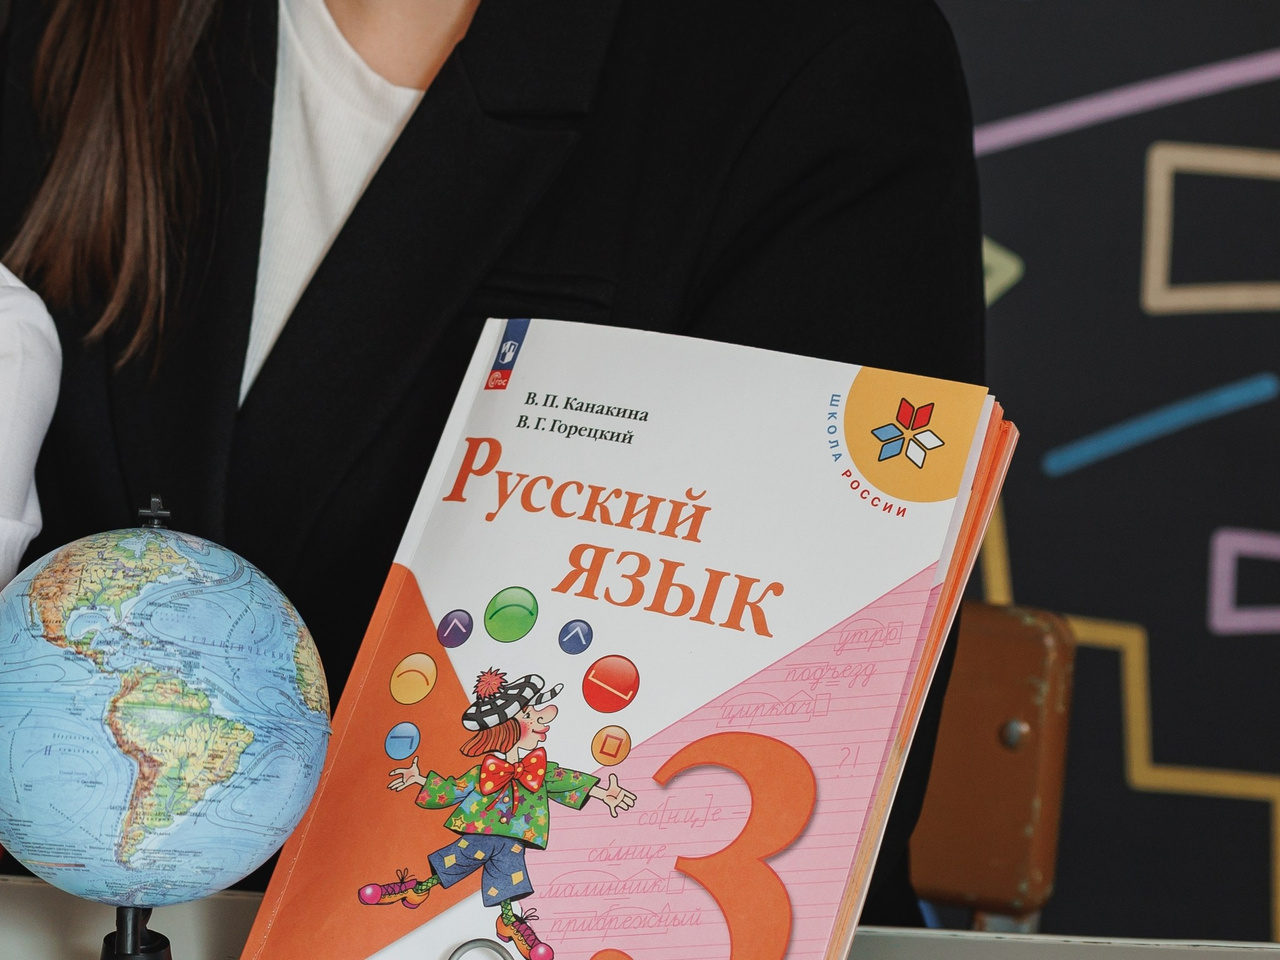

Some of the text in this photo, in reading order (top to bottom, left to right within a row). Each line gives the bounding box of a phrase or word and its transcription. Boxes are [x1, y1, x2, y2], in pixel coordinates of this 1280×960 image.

[524, 391, 650, 422] В. П. Канакина
[516, 414, 635, 445] В. Г. Горецкий
[827, 393, 908, 518] ШКОЛА РОССИИ
[442, 436, 712, 543] Русский
[835, 628, 899, 657] утро
[784, 661, 878, 691] подъезд
[652, 731, 817, 960] 3
[539, 877, 667, 900] малинник
[549, 905, 703, 945] прибрежный
